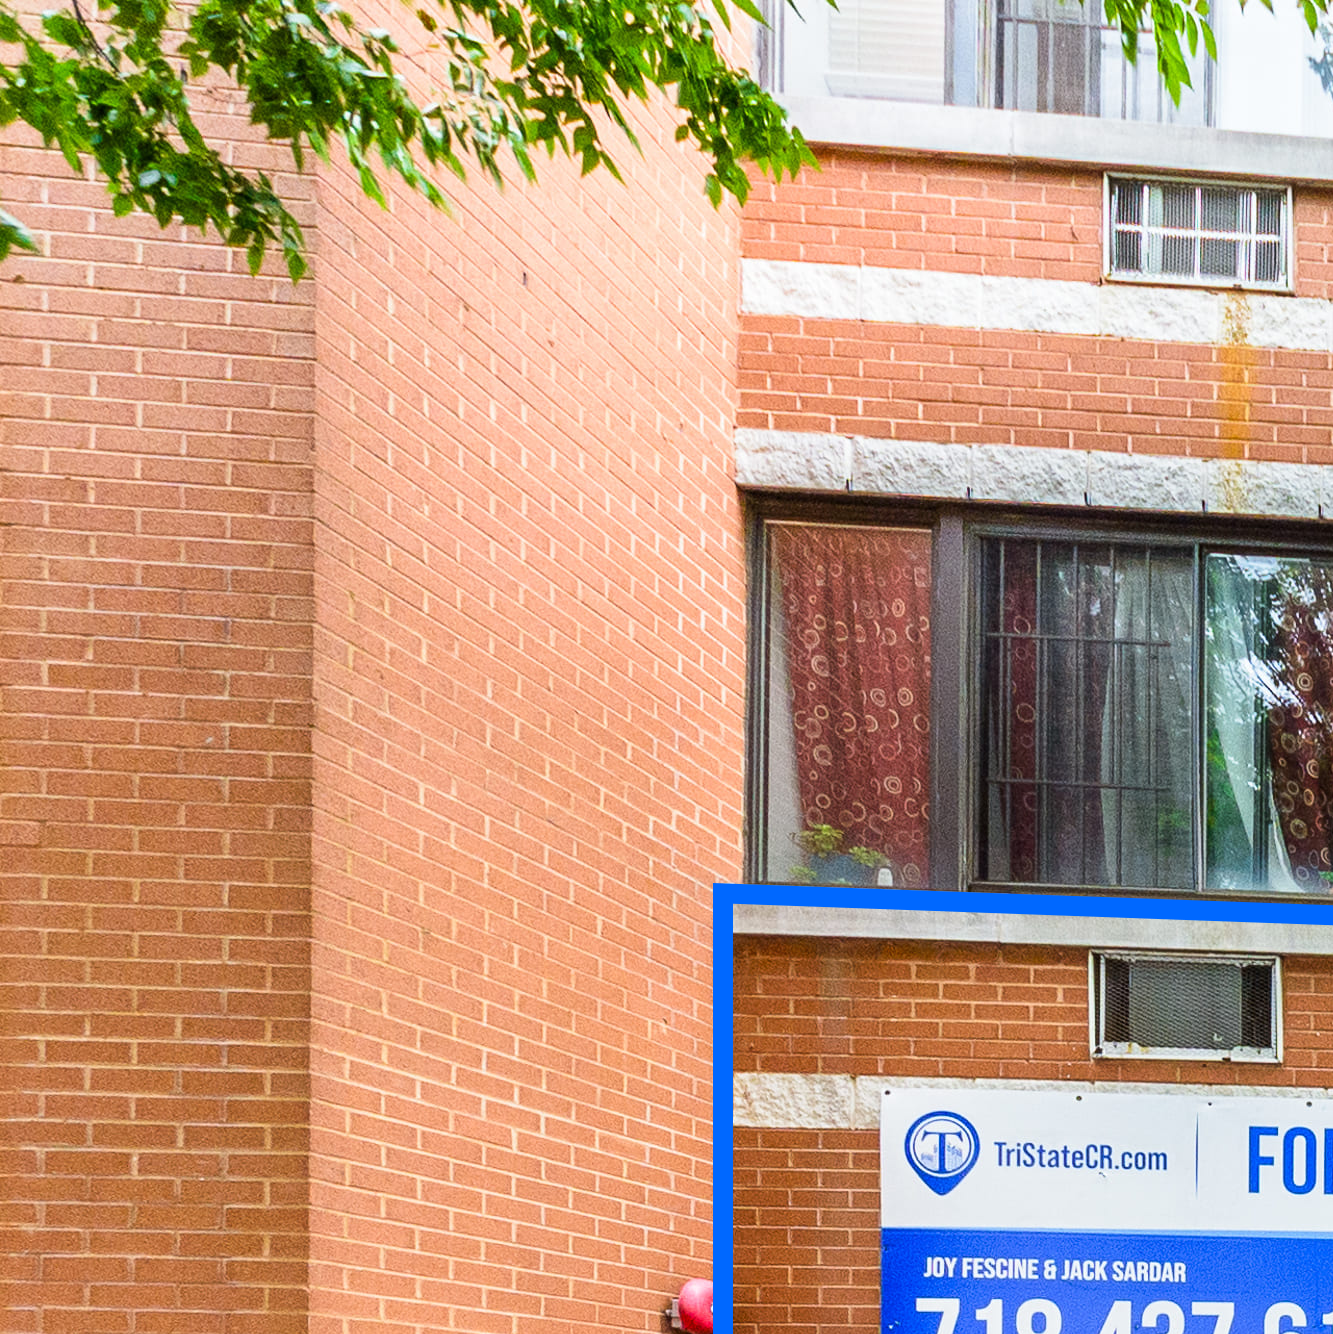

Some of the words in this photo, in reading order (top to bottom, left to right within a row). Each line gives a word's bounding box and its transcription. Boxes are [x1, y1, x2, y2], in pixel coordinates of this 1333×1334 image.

[993, 1141, 1168, 1171] TriStateCR.com
[923, 1256, 958, 1279] JOY
[961, 1258, 1039, 1280] FESCINE
[1043, 1260, 1057, 1280] &
[1061, 1260, 1108, 1282] JACK
[1112, 1262, 1187, 1283] SARDAR
